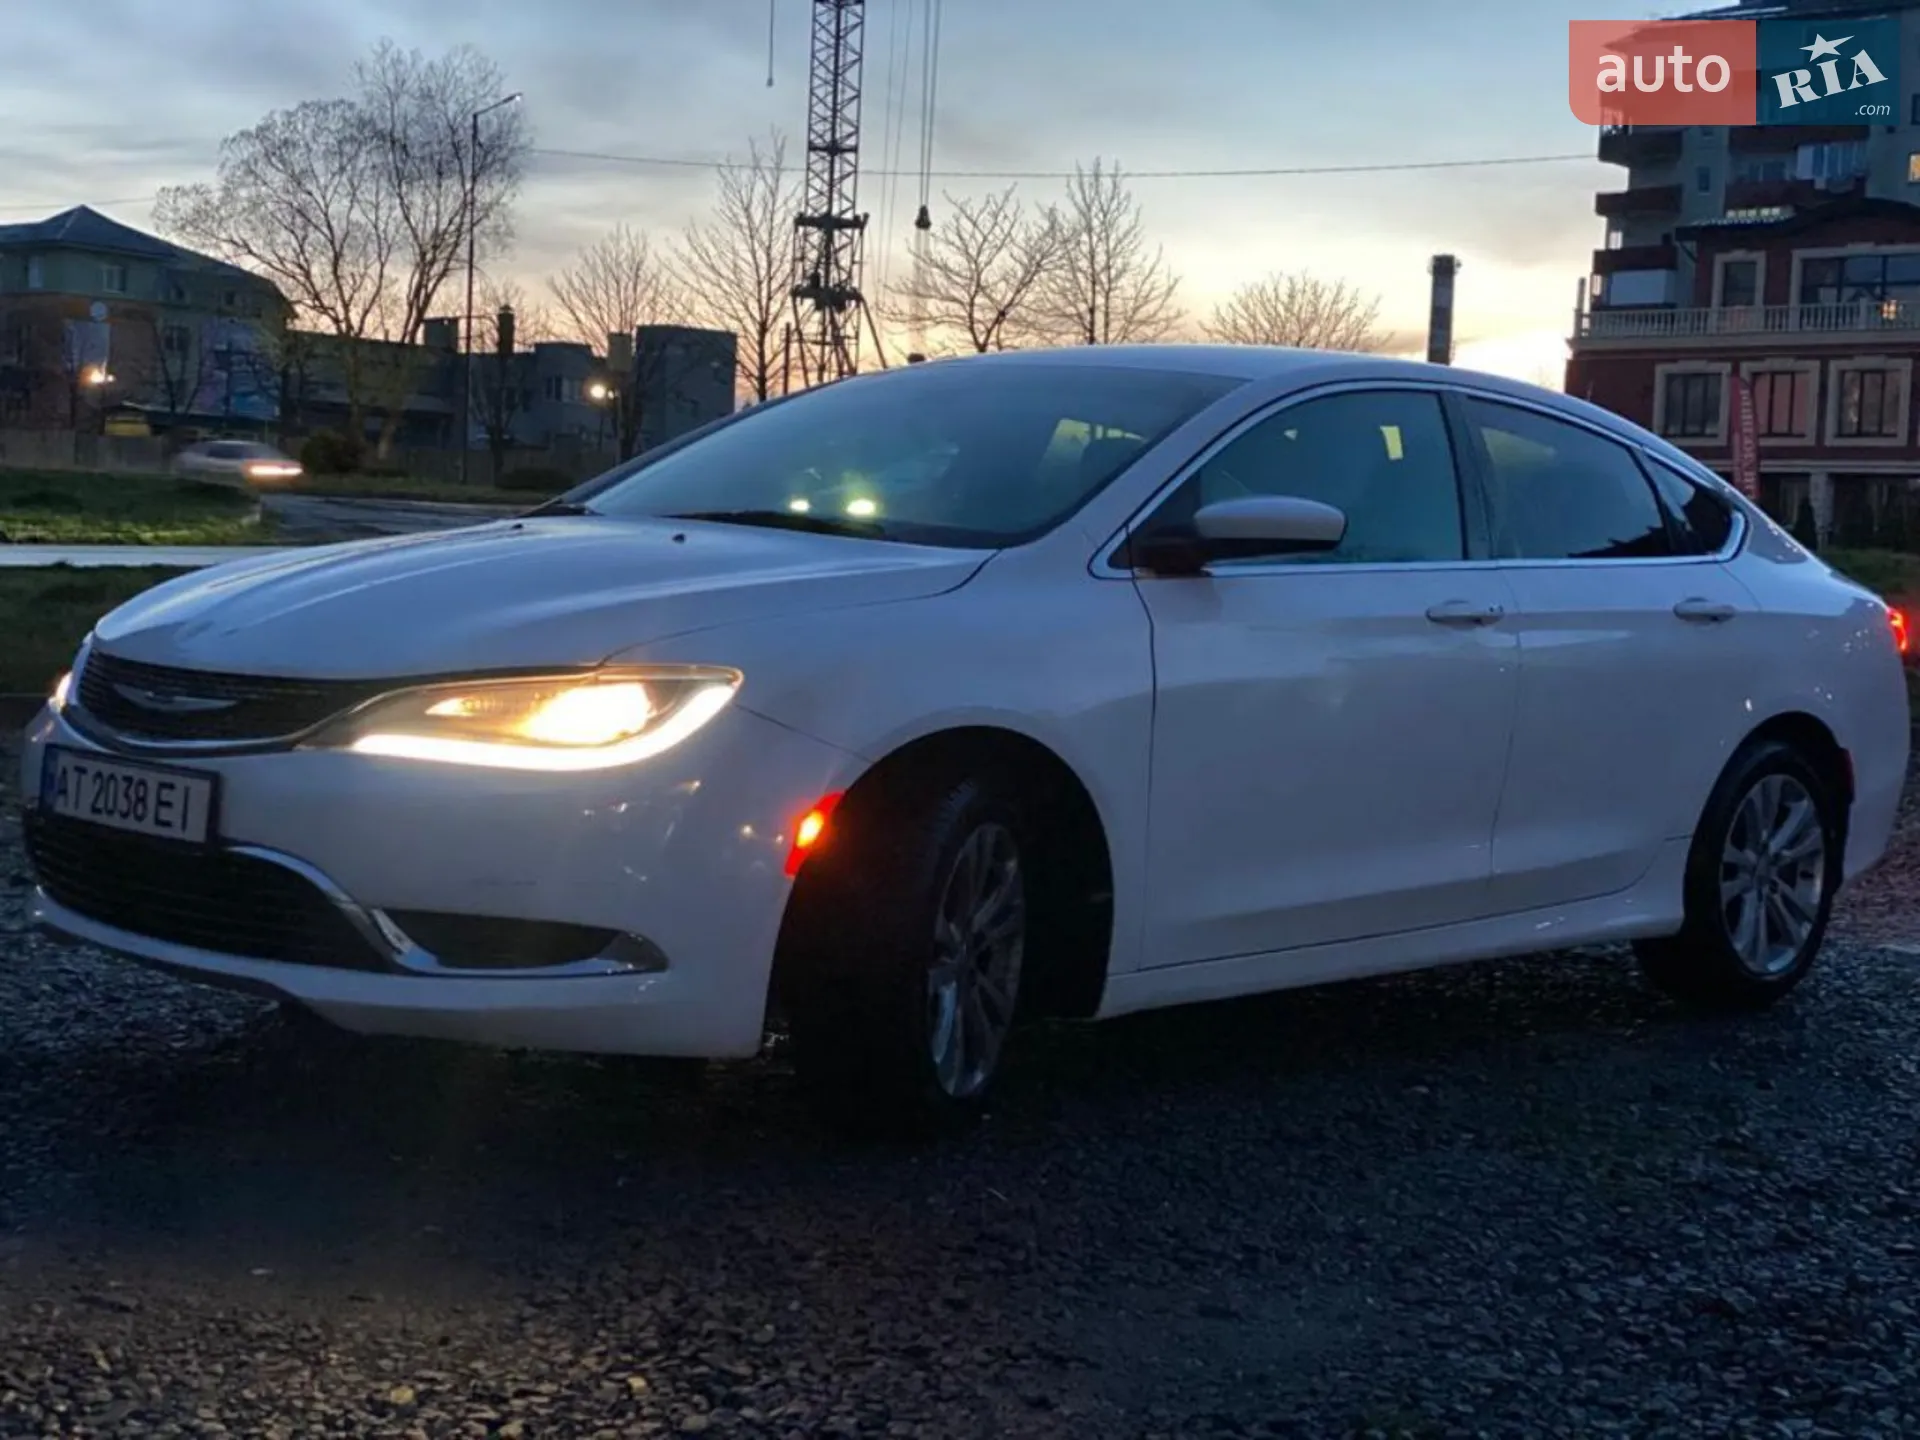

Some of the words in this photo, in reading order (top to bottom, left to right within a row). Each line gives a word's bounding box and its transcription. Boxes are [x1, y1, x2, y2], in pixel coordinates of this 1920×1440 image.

[57, 766, 87, 810] AT
[90, 769, 149, 822] 2038
[154, 781, 190, 832] EI
